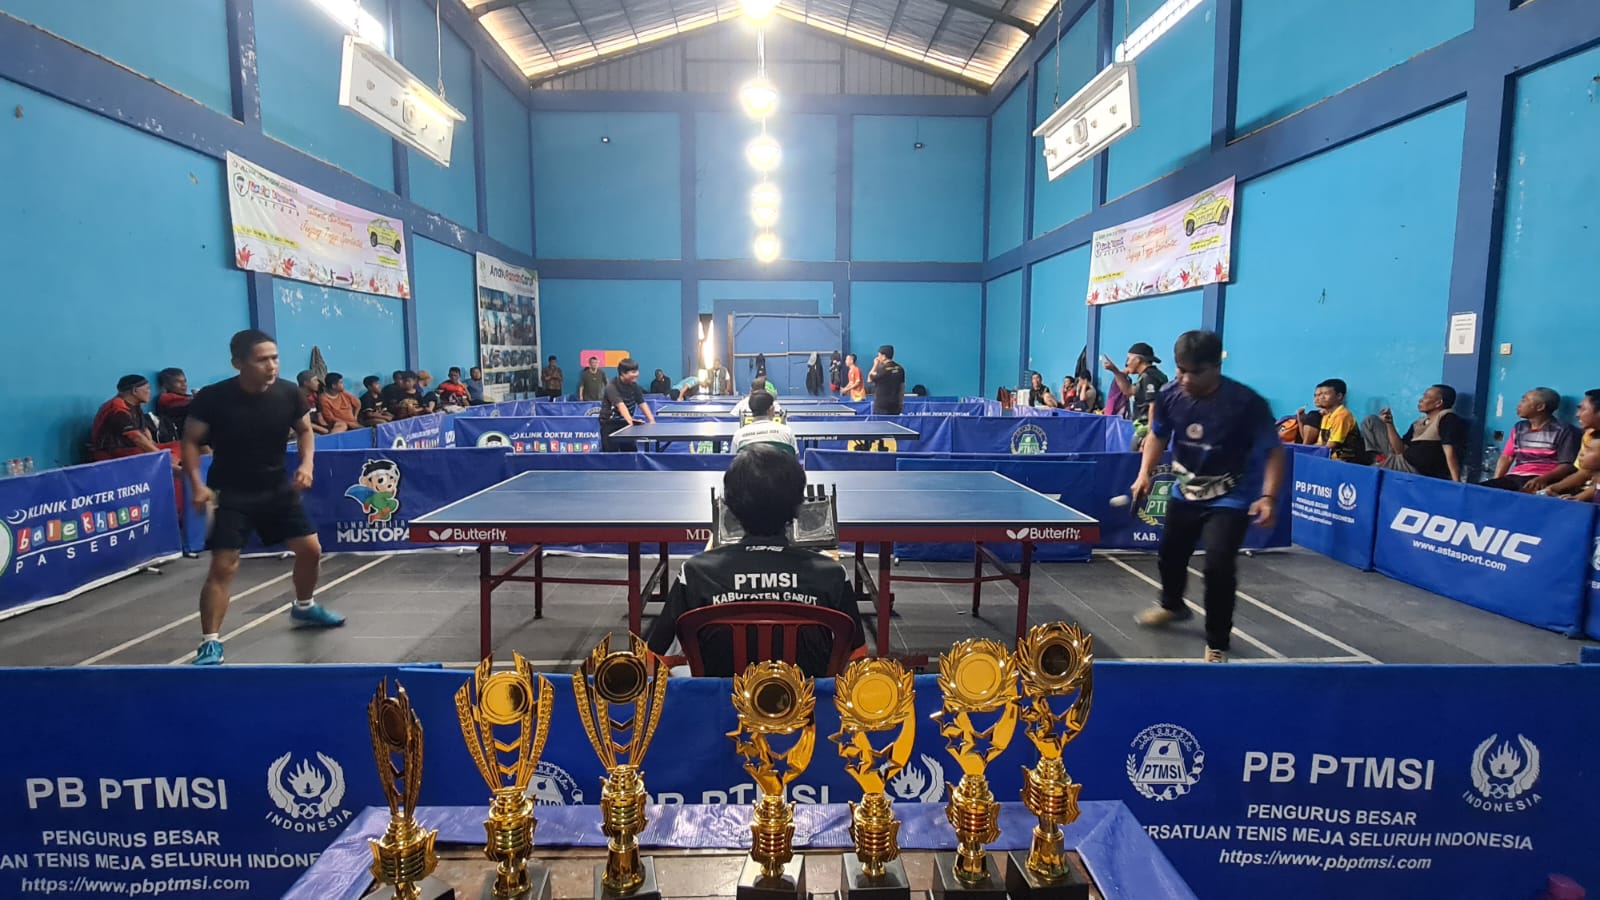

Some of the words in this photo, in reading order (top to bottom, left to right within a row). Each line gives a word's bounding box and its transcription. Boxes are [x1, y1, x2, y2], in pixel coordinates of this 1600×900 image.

[28, 500, 68, 518] KLINIK
[72, 490, 114, 510] DOKTER
[117, 482, 150, 499] TRISNA
[1296, 480, 1306, 492] PB
[1307, 483, 1332, 498] PTMSI
[454, 528, 506, 541] Butterfly
[1030, 528, 1081, 540] Butterfly
[1133, 532, 1160, 542] KAB.
[1390, 507, 1542, 563] DONIC
[16, 525, 150, 574] PASEBAN
[1412, 539, 1506, 572] www.astasport.com
[734, 572, 798, 590] PTMSI
[712, 592, 780, 606] KABUPATEN
[783, 592, 818, 606] GARUT
[1142, 764, 1182, 780] PTMSI
[1242, 750, 1296, 784] PB
[1309, 753, 1436, 790] PTMSI
[26, 777, 87, 809] PB
[100, 777, 228, 810] PTMSI
[1462, 790, 1542, 812] INDONESIA
[265, 810, 352, 832] INDONESIA
[1247, 804, 1351, 826] PENGURUS
[1355, 810, 1417, 826] BESAR
[42, 830, 147, 848] PENGURUS
[154, 830, 220, 846] BESAR
[1142, 824, 1231, 840] RSATUAN
[1236, 826, 1287, 842] TENIS
[1292, 828, 1343, 846] MEJA
[1349, 832, 1431, 848] SELURUH
[1434, 832, 1533, 850] INDONESIA
[34, 853, 90, 868] TENIS
[96, 854, 146, 870] MEJA
[150, 852, 242, 870] SELURUH
[248, 852, 320, 868] INDONE
[1219, 849, 1431, 872] https://www.pbptmsi.com
[22, 876, 250, 896] https://www.pbptmsi.com
